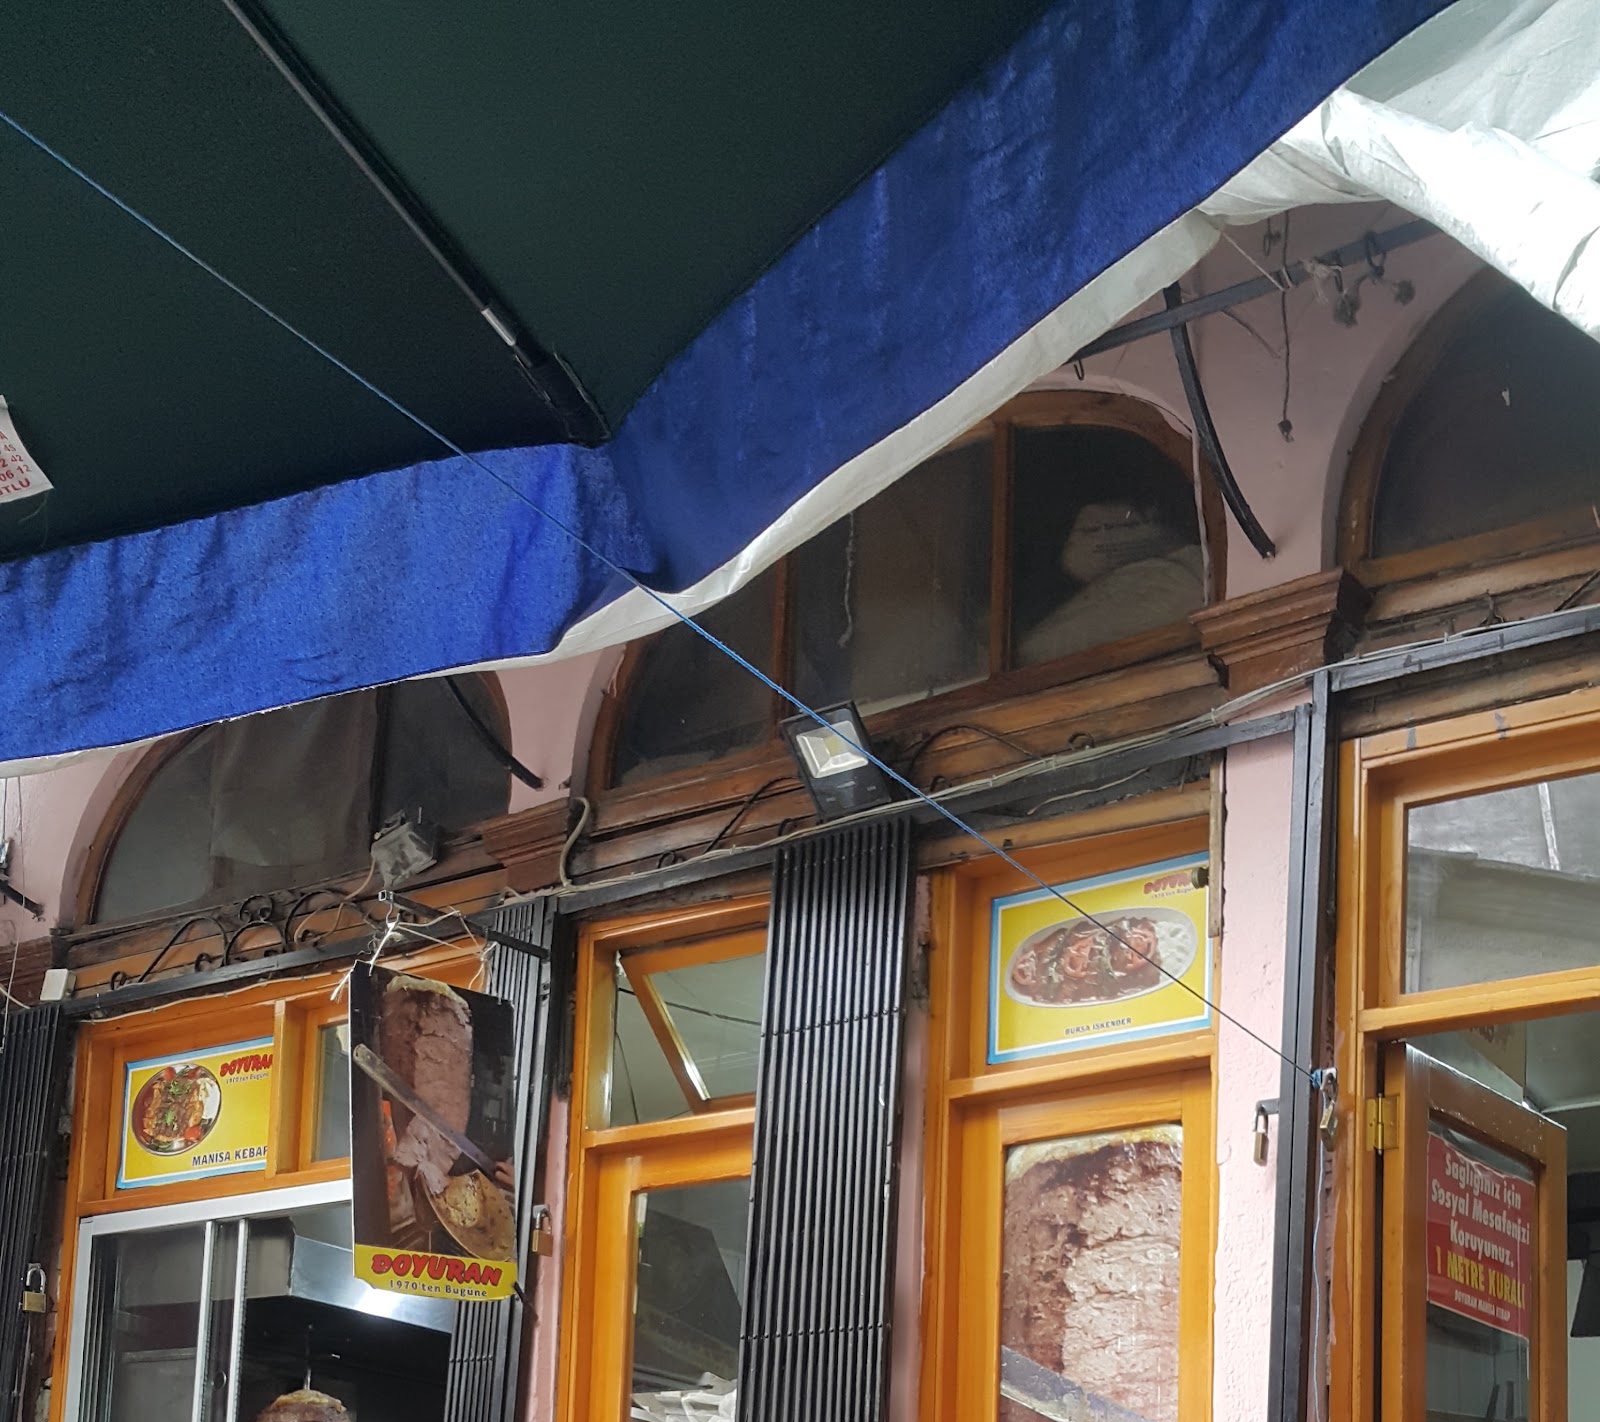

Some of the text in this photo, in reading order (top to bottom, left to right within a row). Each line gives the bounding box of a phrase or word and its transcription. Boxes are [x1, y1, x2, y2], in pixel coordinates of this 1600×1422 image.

[192, 1151, 231, 1166] MANISA
[1431, 1178, 1469, 1217] Sosyal
[371, 1254, 503, 1286] DOYURAN
[1447, 1250, 1485, 1292] METRE
